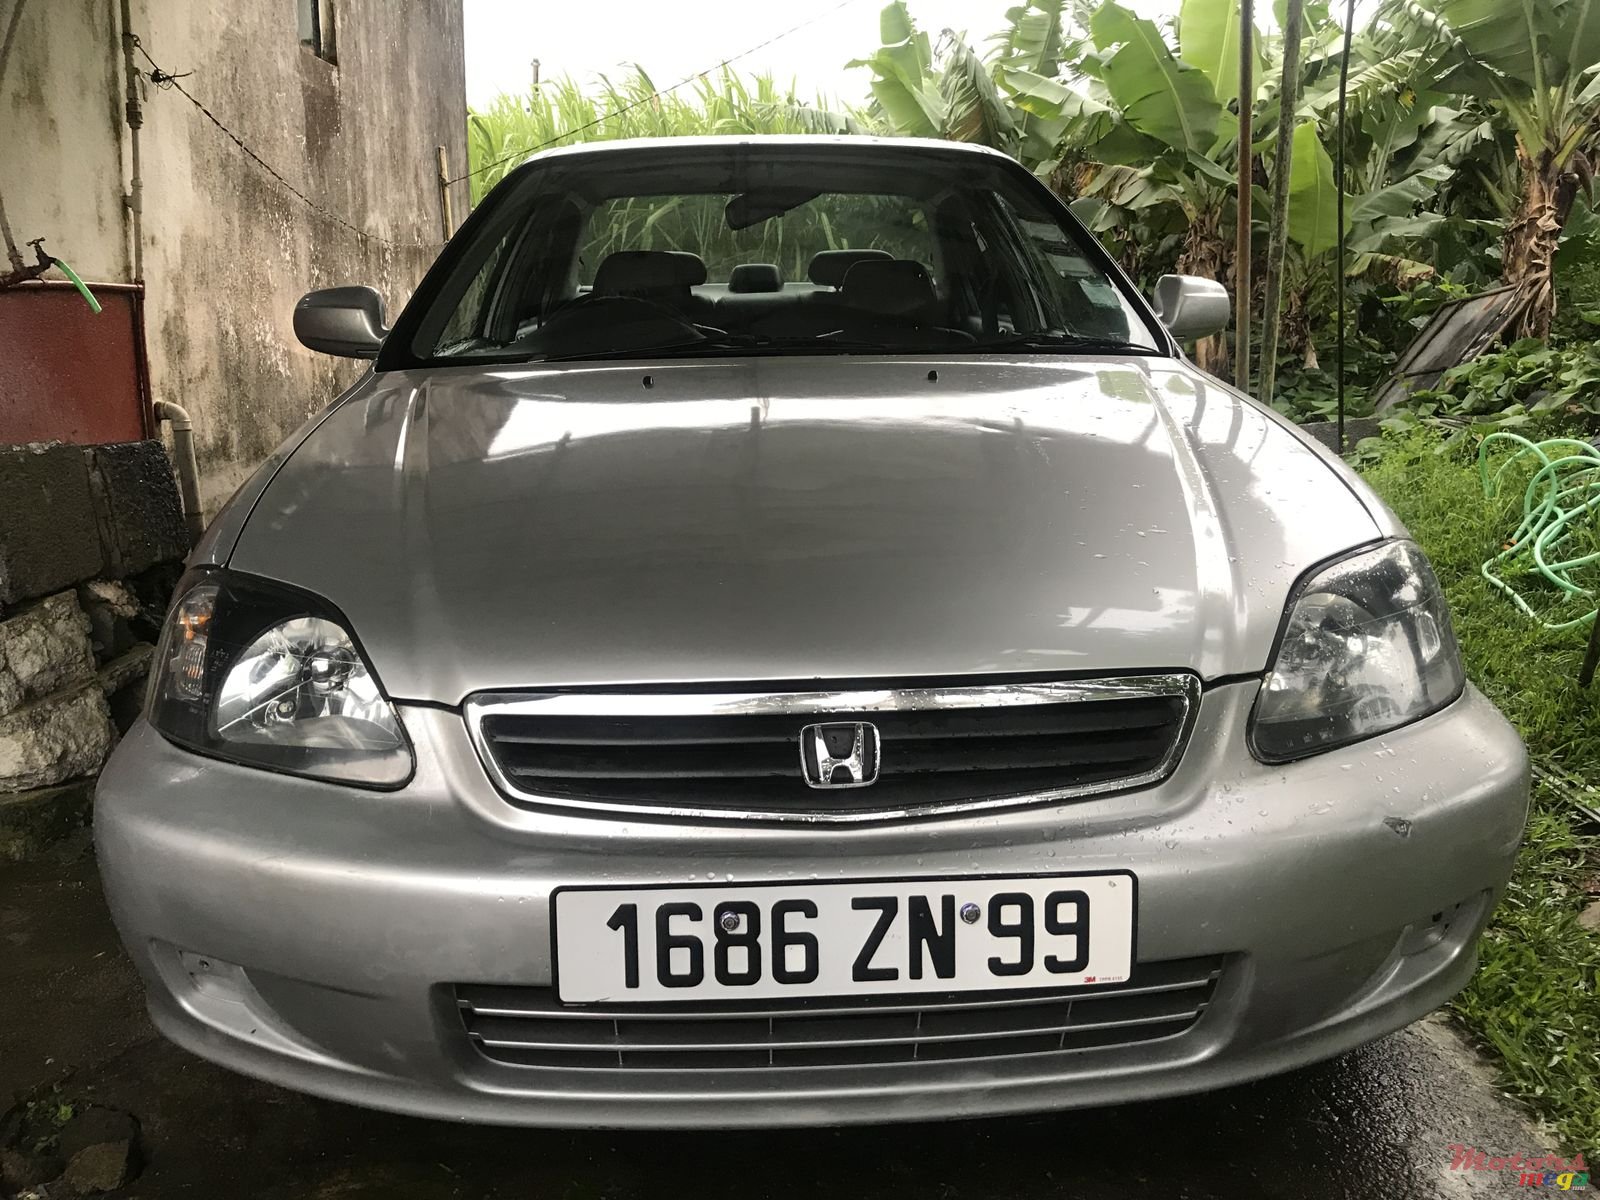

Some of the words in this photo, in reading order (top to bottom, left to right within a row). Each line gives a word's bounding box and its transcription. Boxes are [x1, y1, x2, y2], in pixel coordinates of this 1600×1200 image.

[606, 899, 820, 989] 1686
[851, 894, 956, 983] ZN
[987, 890, 1090, 977] 99
